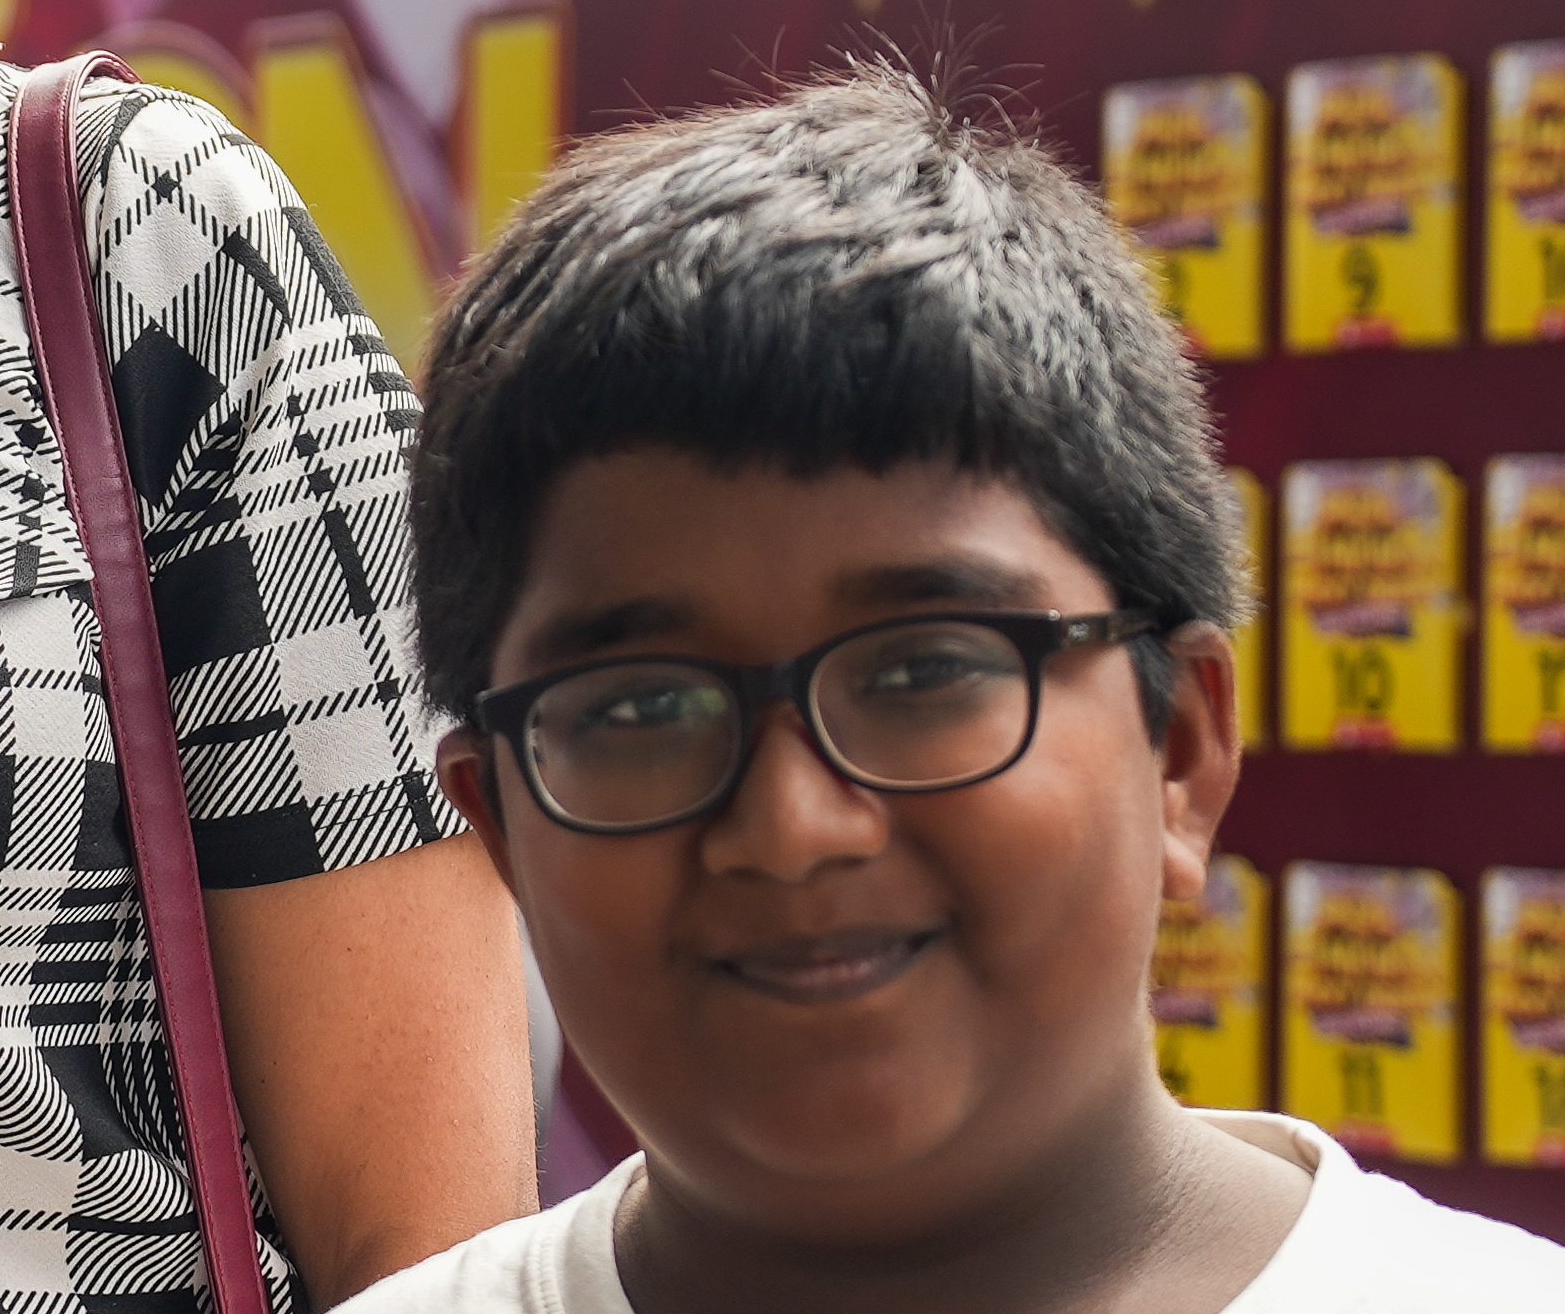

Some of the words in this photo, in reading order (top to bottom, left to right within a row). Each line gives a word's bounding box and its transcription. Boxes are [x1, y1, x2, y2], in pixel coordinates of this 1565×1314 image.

[1341, 241, 1380, 310] 9
[1333, 648, 1391, 714] 10
[1340, 1053, 1385, 1118] 11
